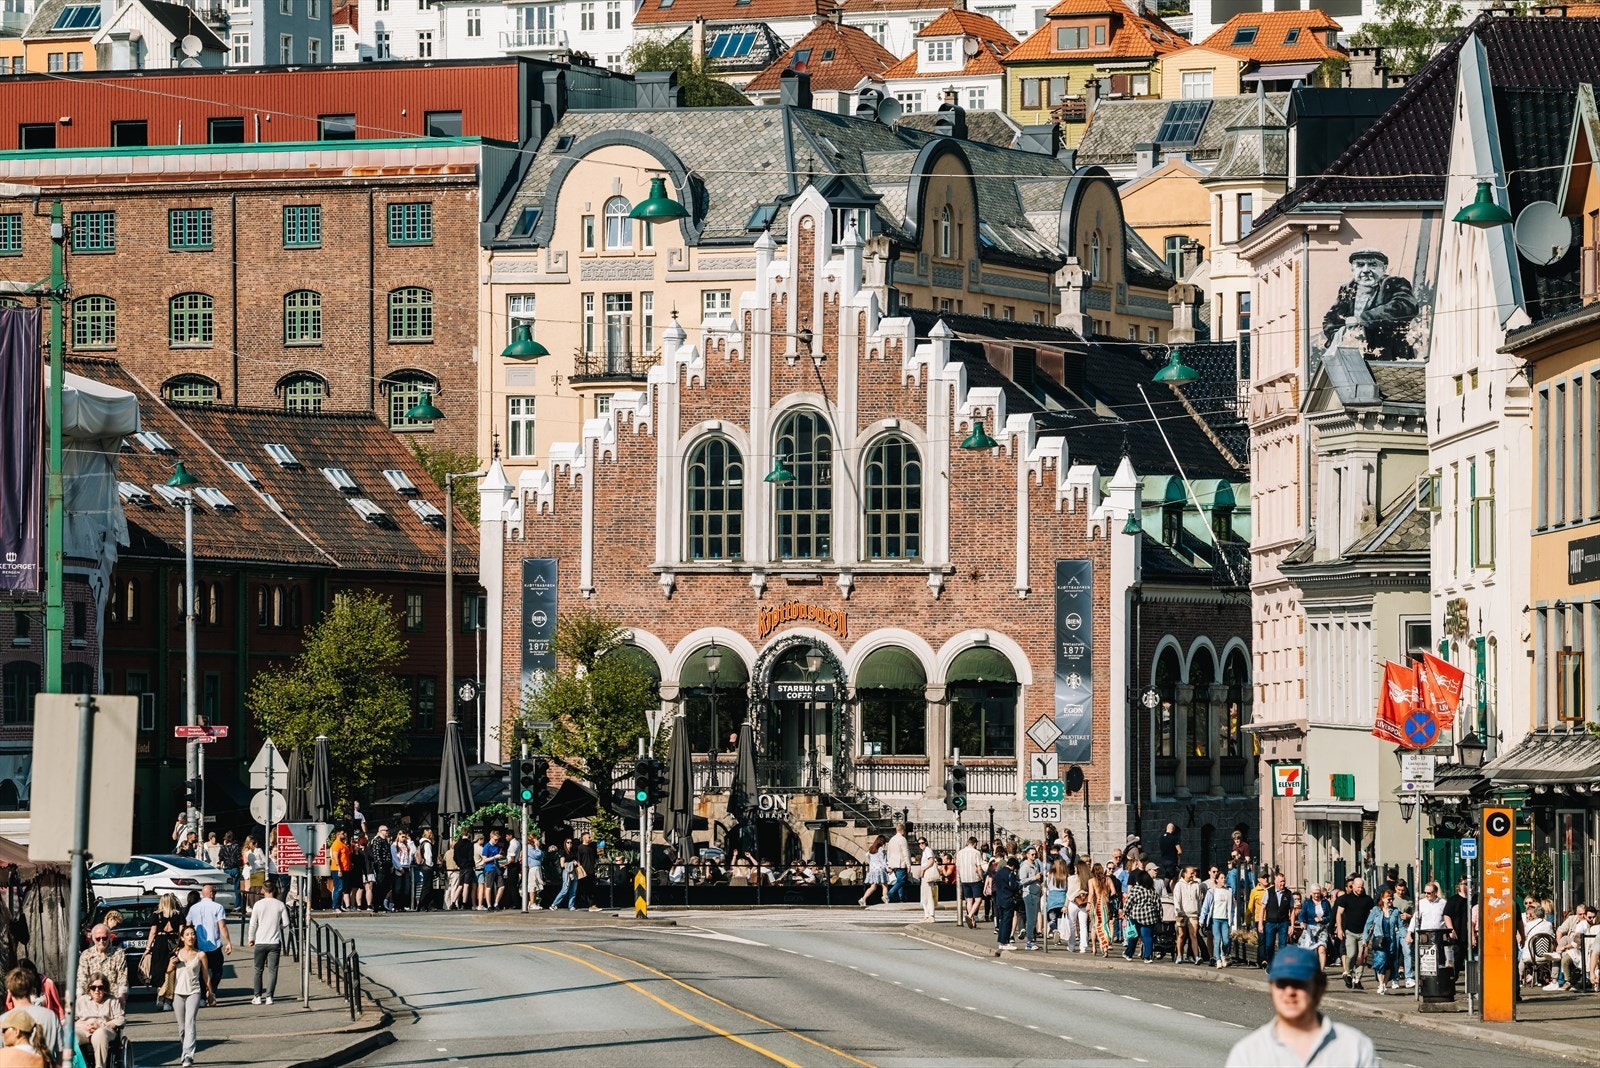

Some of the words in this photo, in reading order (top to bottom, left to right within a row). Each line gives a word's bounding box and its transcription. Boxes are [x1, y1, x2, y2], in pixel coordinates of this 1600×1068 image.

[1279, 769, 1299, 796] 7
[1031, 786, 1038, 797] E
[1042, 786, 1059, 797] 39
[758, 794, 787, 811] ON
[1032, 807, 1057, 819] 585
[1492, 817, 1505, 832] C
